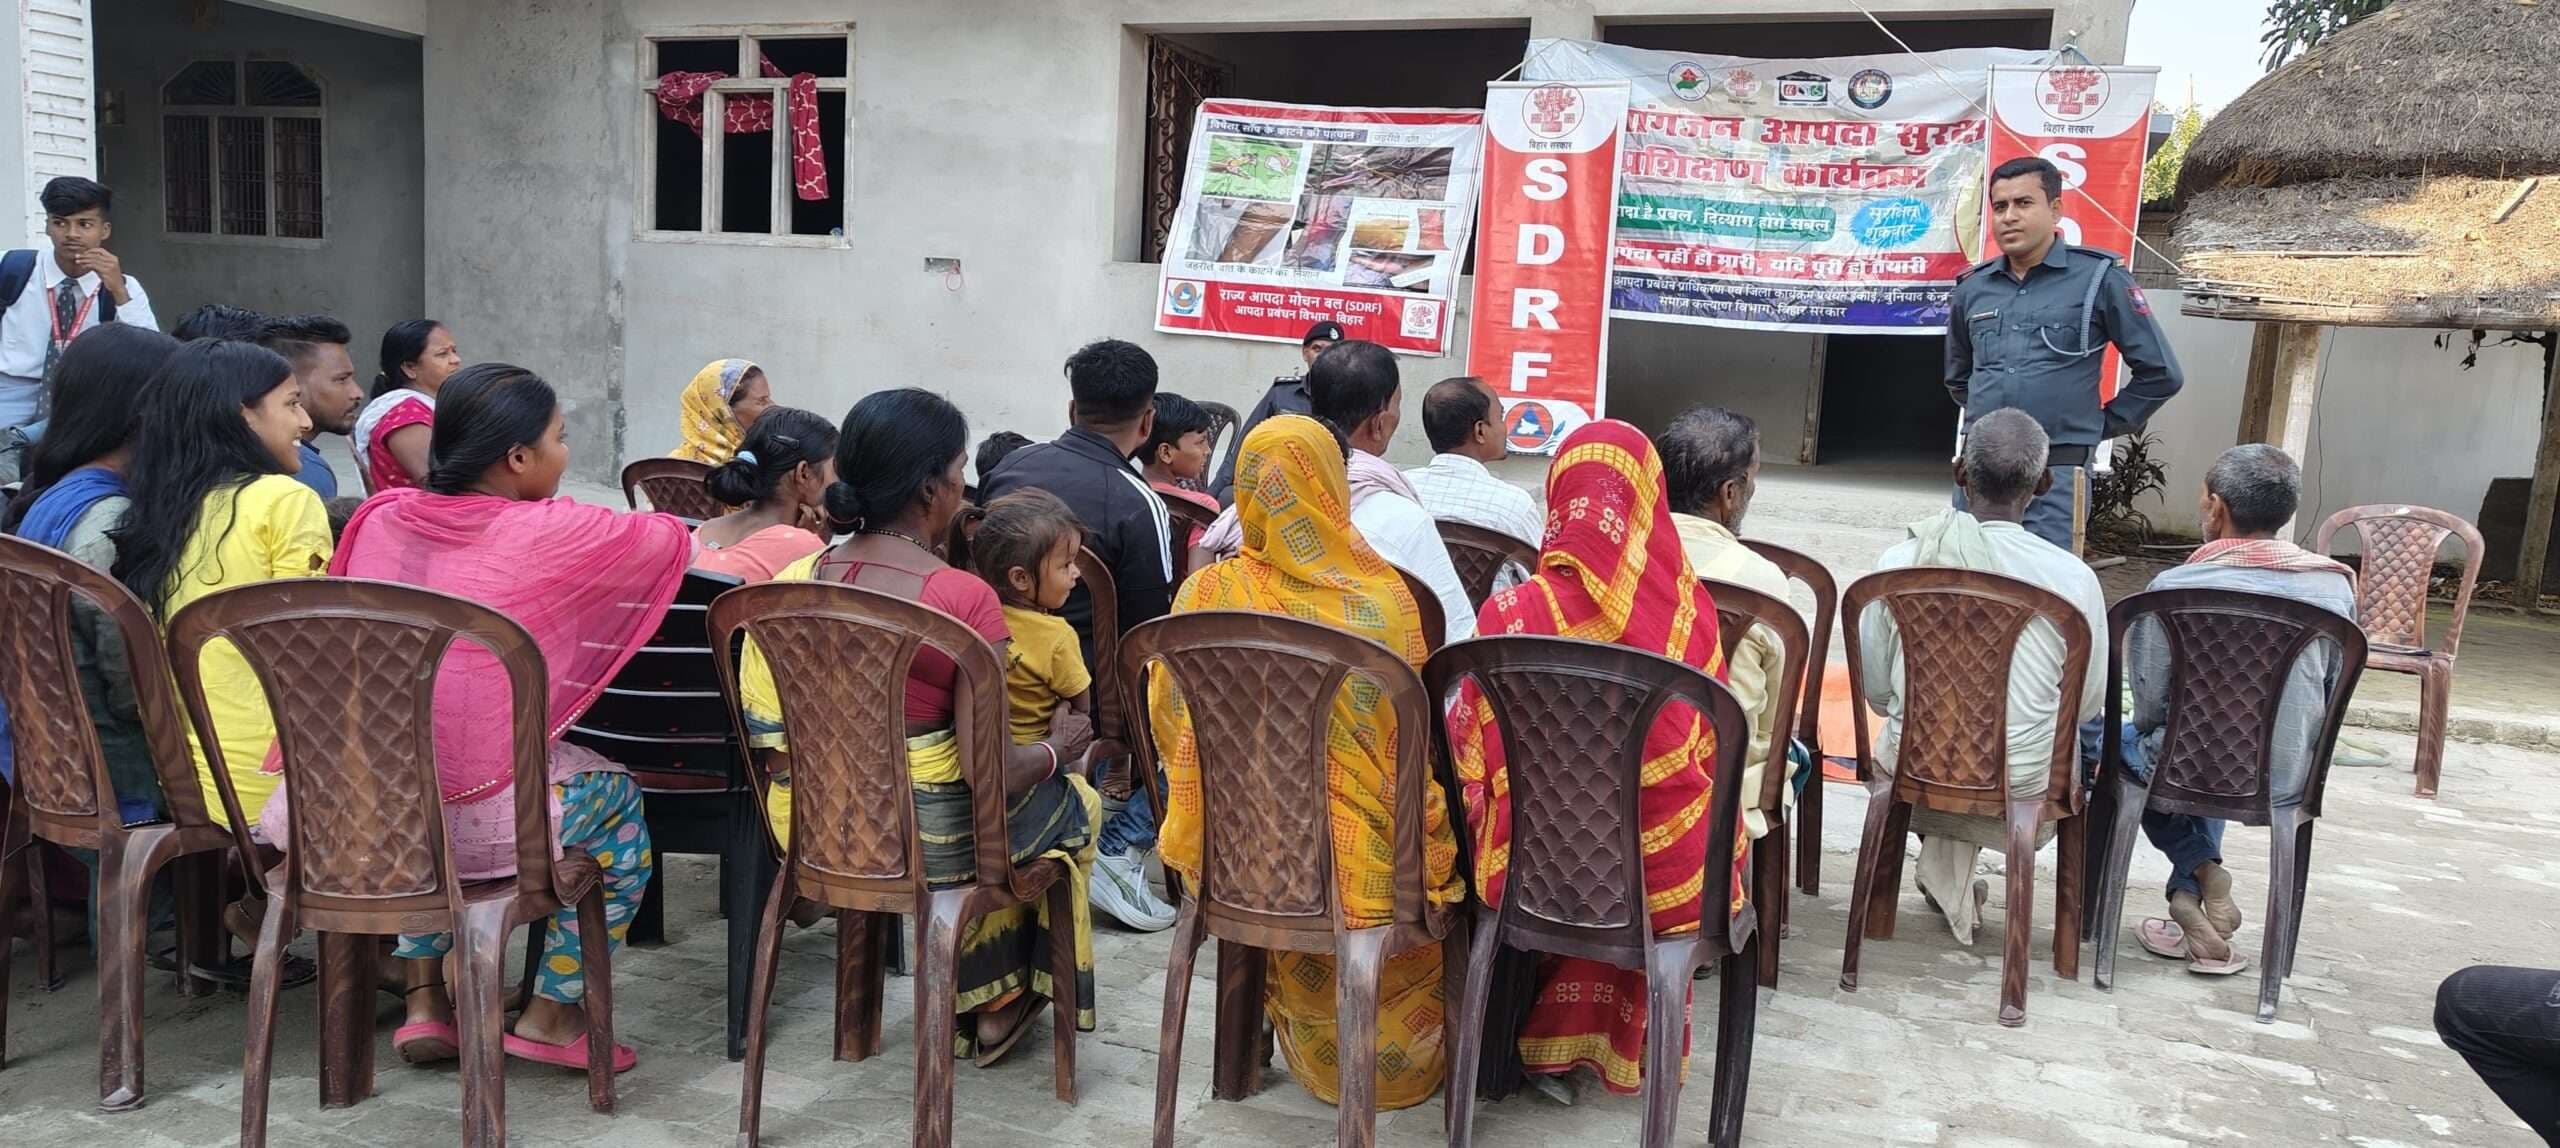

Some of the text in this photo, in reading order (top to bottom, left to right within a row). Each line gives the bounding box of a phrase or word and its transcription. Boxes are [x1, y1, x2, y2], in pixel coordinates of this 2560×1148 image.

[1760, 117, 1881, 146] आपदा
[1896, 119, 1986, 156] सुरक्ष
[2043, 122, 2096, 135] बिहार सरकार
[1529, 138, 1573, 151] बिहार सरकार
[1782, 157, 1931, 190] कार्यक्रम
[1643, 202, 1653, 220] है
[1656, 207, 1697, 225] प्रबल,
[1704, 207, 1754, 228] दिव्यांग
[1759, 211, 1785, 229] होंगे
[1790, 218, 1830, 232] सबल
[1510, 158, 1568, 392] SDRF
[1657, 247, 1692, 264] नहीं
[1694, 249, 1713, 266] हो
[1717, 252, 1762, 273] भारी,
[1770, 256, 1805, 273] यदि
[1812, 258, 1843, 279] पूरी
[1848, 258, 1865, 275] हो
[1871, 256, 1928, 275] तैयारी
[1220, 288, 1382, 315] राज्य आपदा मोचन बल (SDRF)
[1614, 275, 1643, 287] आपदा
[1646, 277, 1676, 290] प्रबंधन
[1678, 279, 1725, 294] प्राधिकरण
[1745, 284, 1771, 298] जिला
[1884, 288, 1924, 304] बुनियाद
[1234, 305, 1264, 318] आपदा
[1267, 306, 1296, 320] प्रबंधन
[1336, 311, 1366, 326] बिहार
[1659, 295, 1689, 309] समाज
[1692, 299, 1733, 312] कल्याण
[1778, 302, 1808, 317] बिहार
[1810, 305, 1848, 318] सरकार
